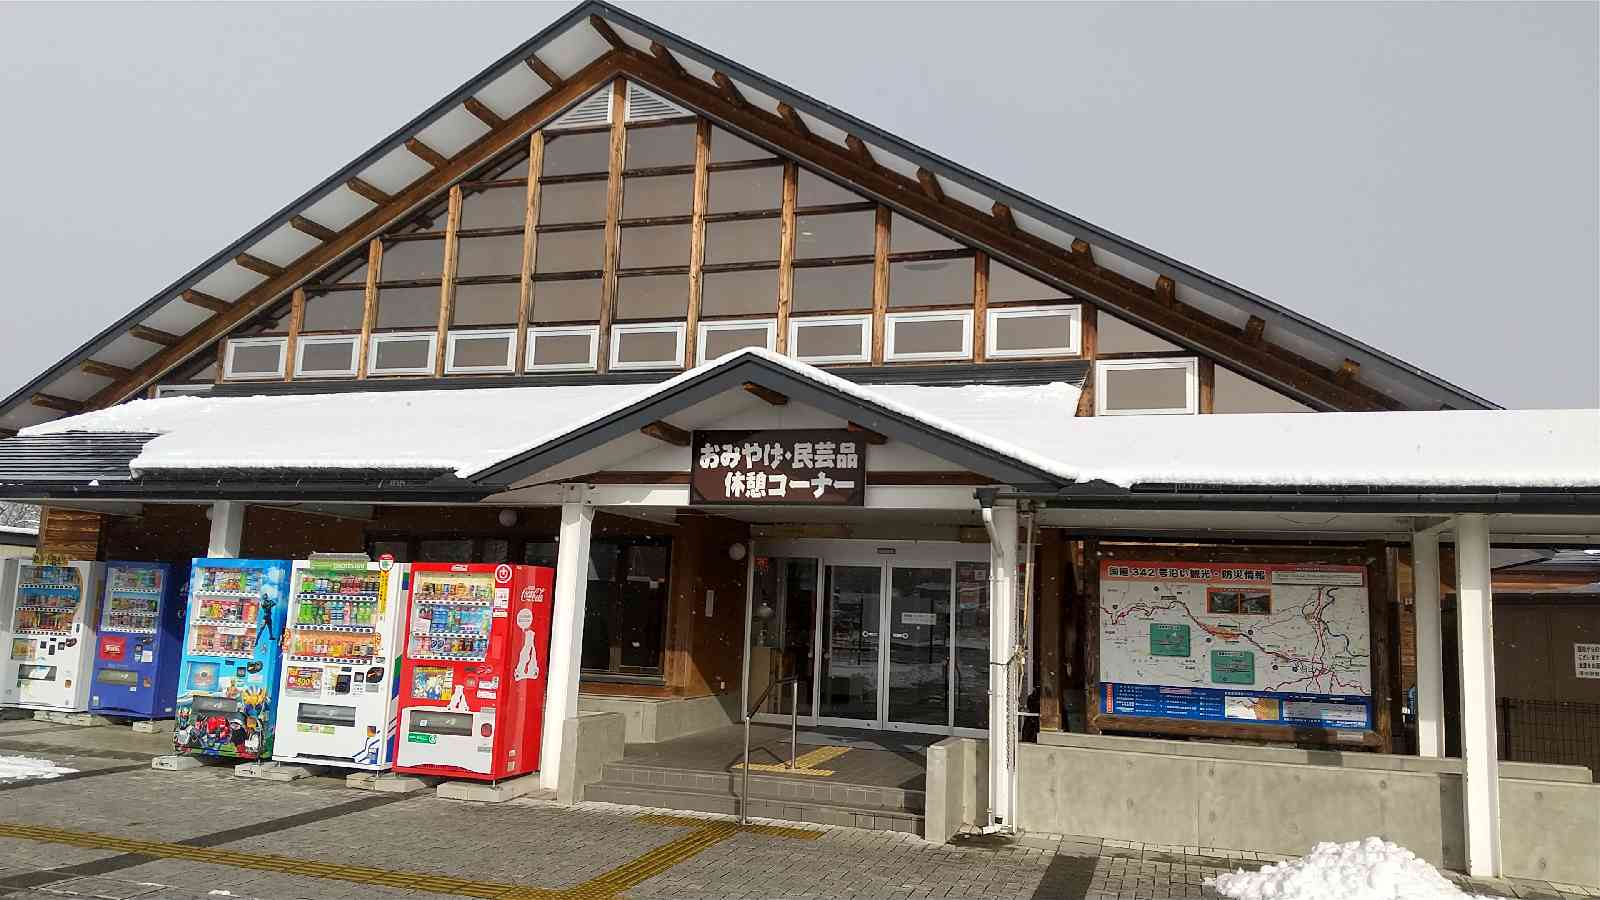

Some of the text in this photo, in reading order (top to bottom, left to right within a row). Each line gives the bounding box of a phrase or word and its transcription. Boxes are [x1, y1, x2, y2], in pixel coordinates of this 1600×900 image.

[725, 471, 855, 499] 休憩コーナー
